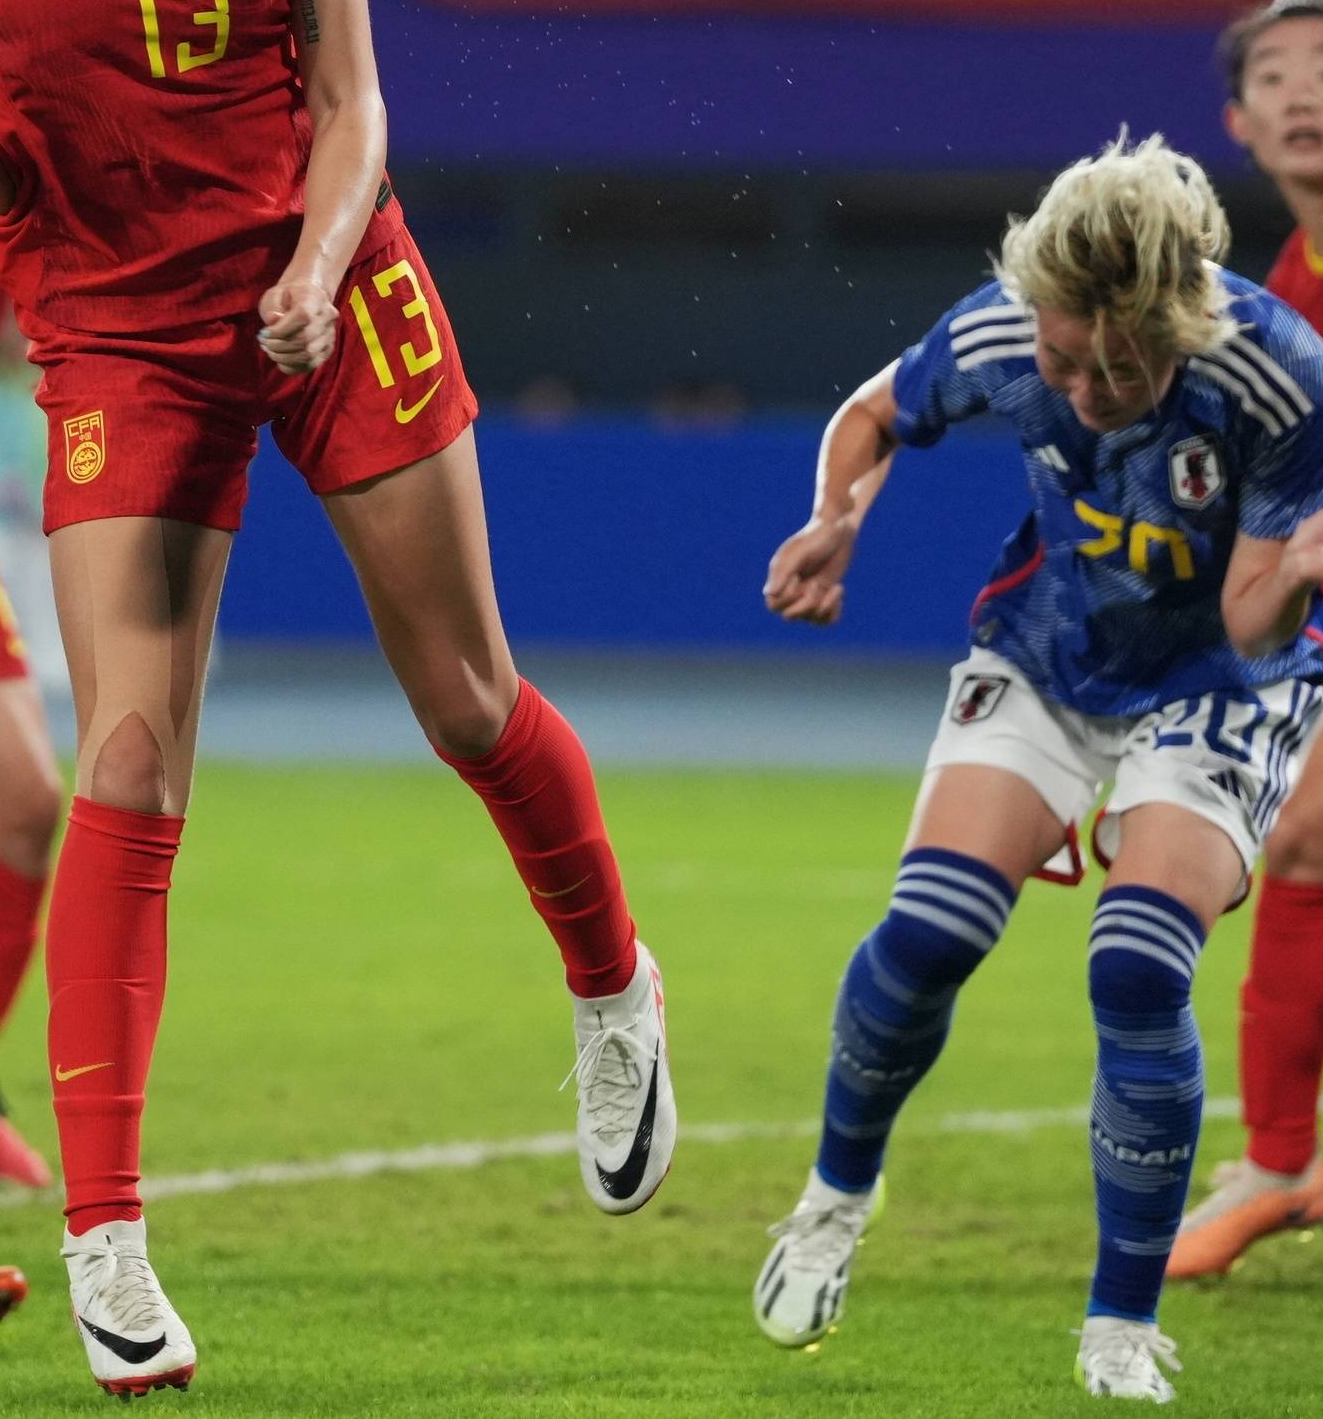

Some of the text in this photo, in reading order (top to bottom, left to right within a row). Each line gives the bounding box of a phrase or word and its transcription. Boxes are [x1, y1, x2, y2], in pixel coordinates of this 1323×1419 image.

[348, 259, 443, 389] 13
[68, 416, 100, 437] CFA
[1153, 688, 1269, 764] 20
